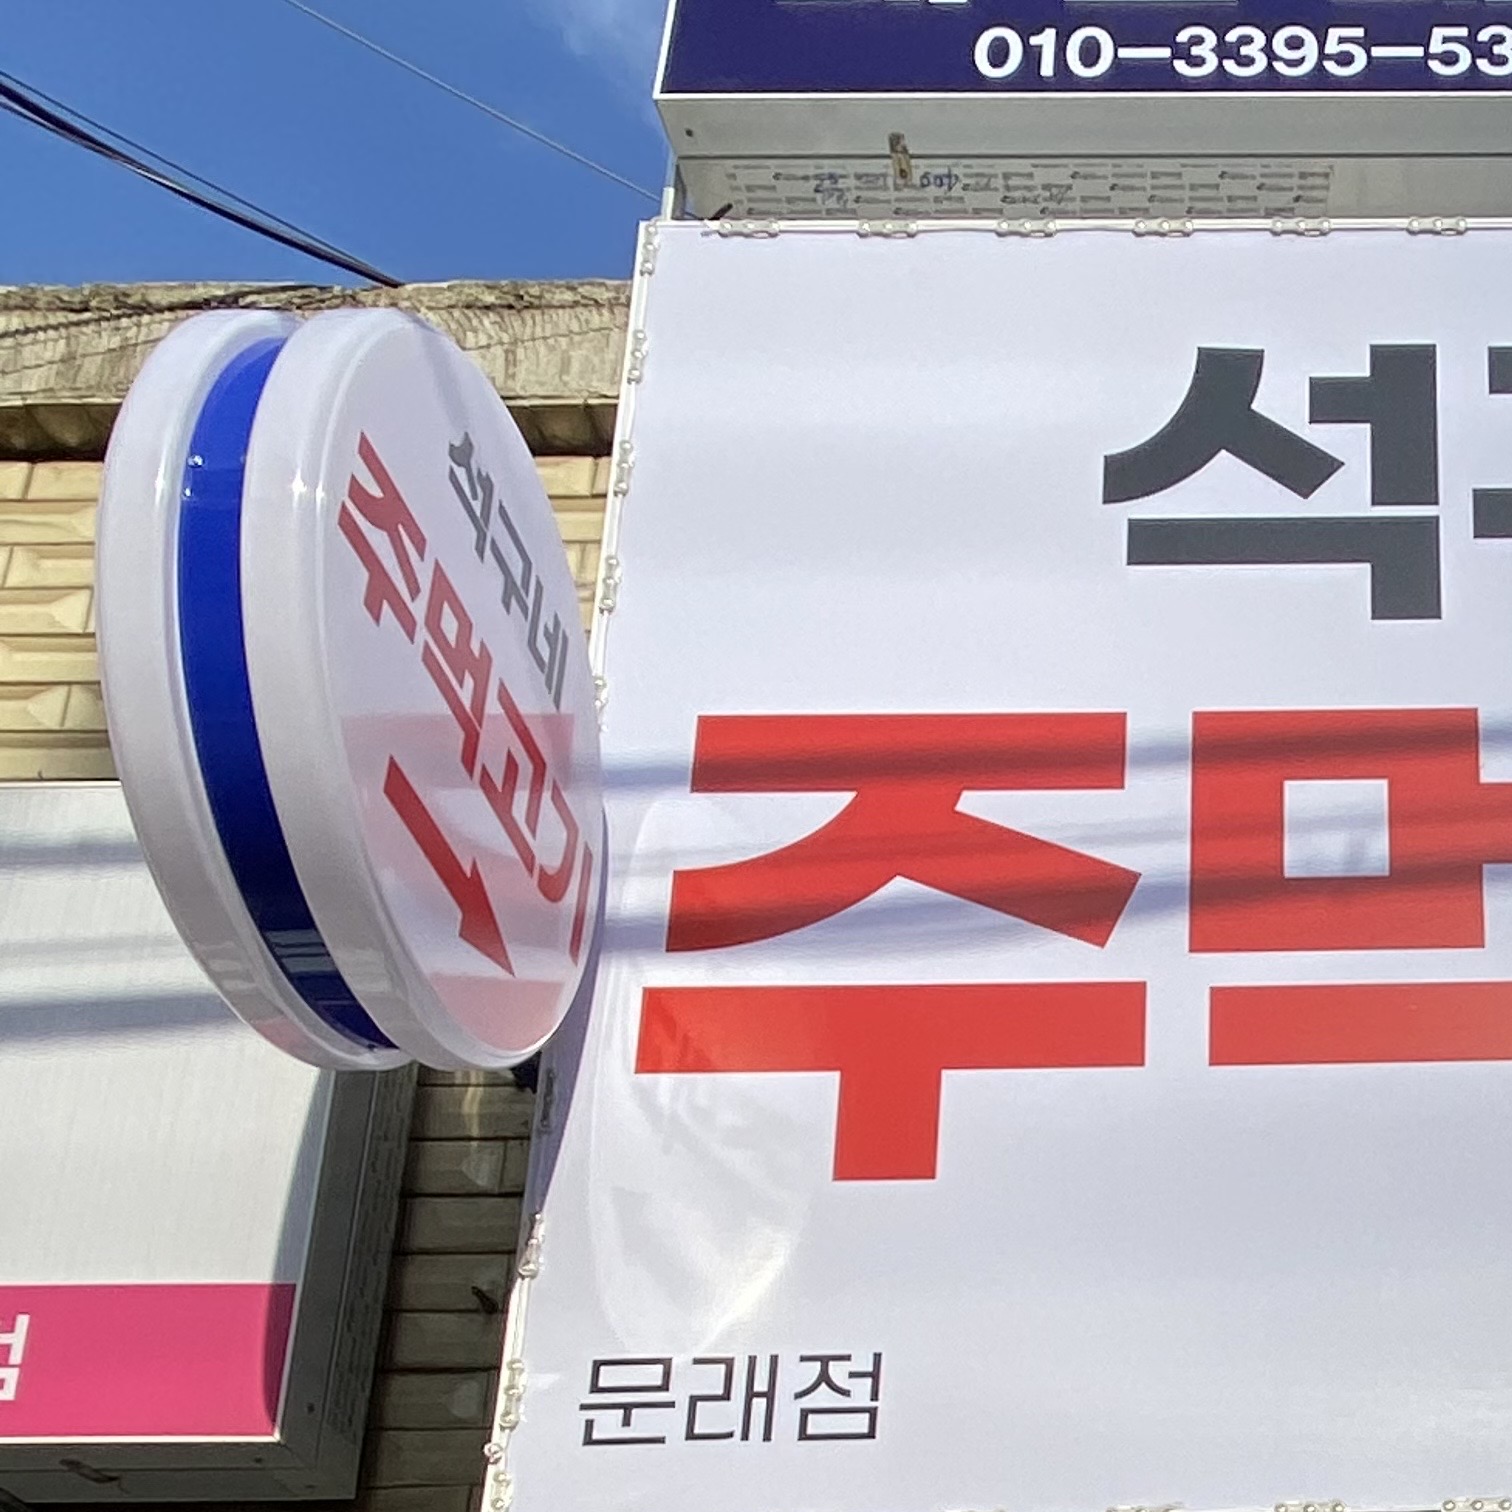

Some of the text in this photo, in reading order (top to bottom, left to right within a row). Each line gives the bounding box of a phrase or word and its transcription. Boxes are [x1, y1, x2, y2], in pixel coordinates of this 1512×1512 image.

[337, 430, 594, 965] 주먹고기
[448, 431, 572, 710] 석구네
[578, 1351, 883, 1447] 문래점
